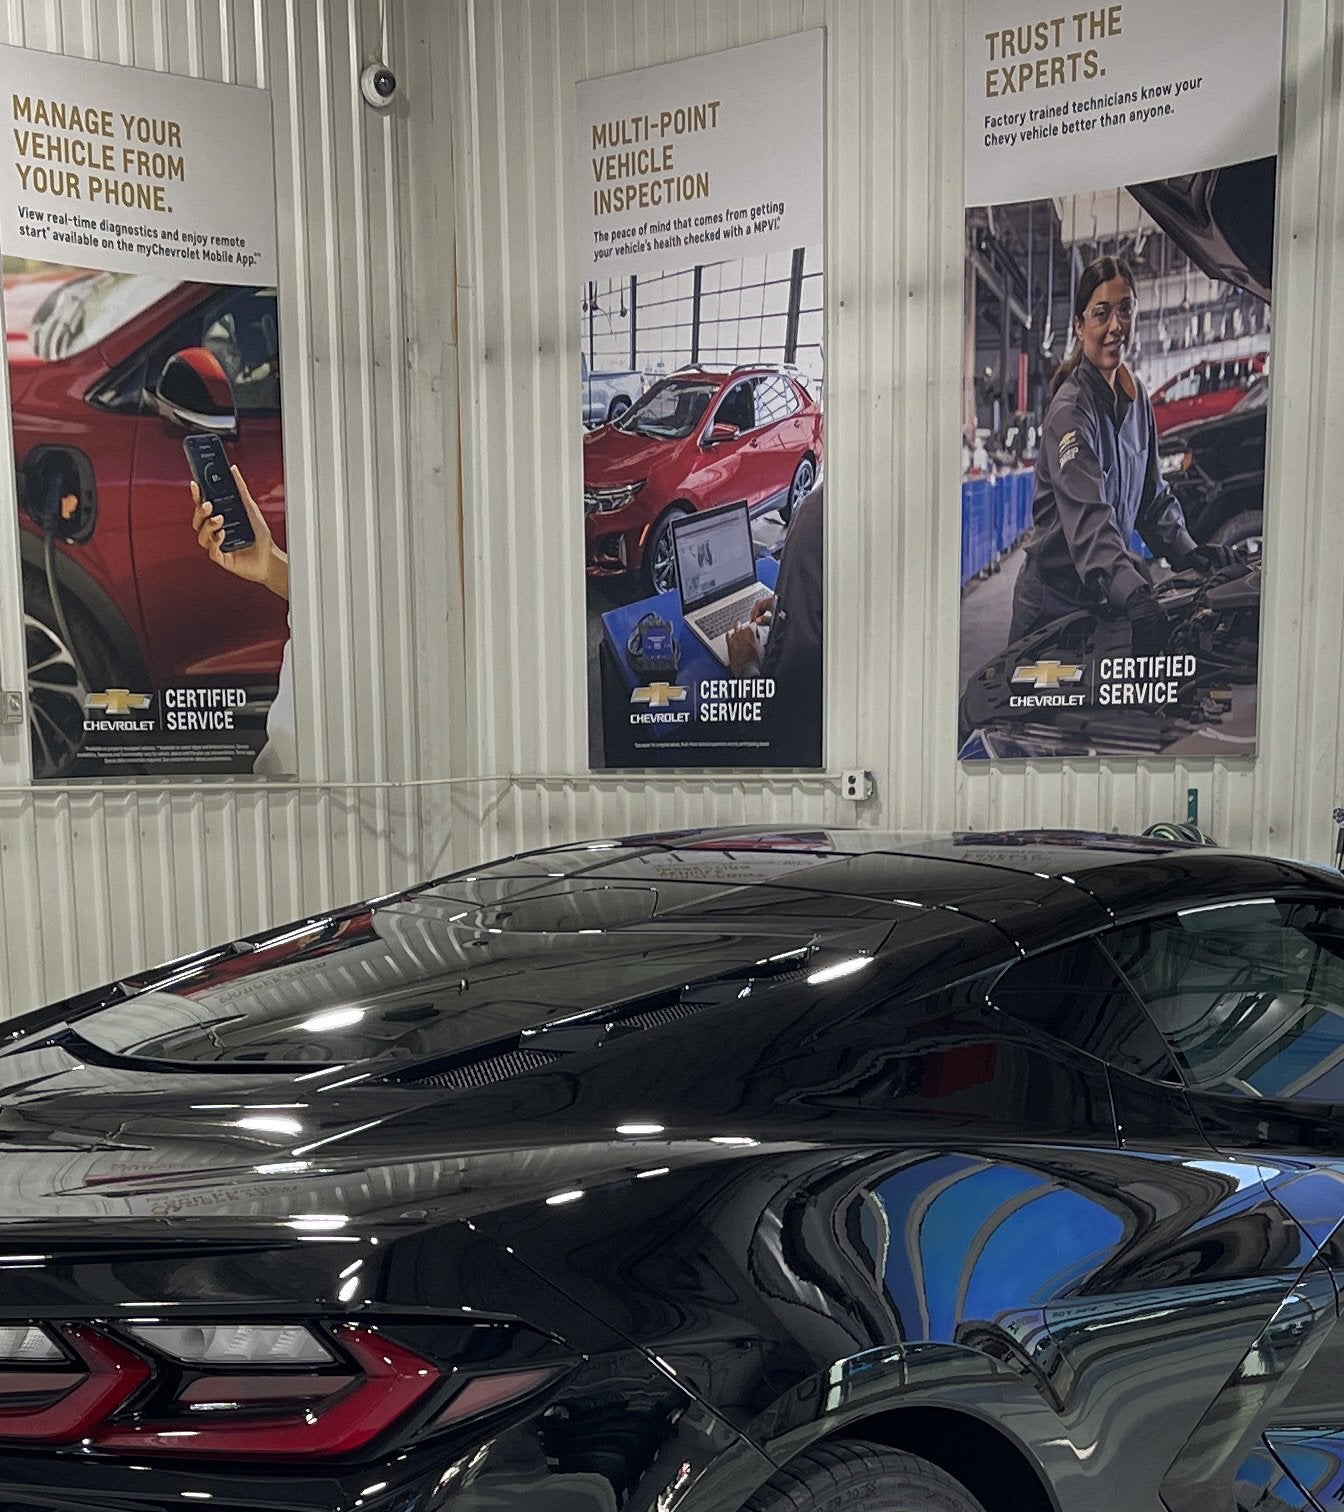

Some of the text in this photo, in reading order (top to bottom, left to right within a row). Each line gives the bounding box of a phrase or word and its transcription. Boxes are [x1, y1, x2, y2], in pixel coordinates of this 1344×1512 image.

[984, 5, 1123, 61] TRUST THE
[985, 49, 1106, 98] EXPERTS.
[12, 94, 182, 149] MANAGE YOUR
[984, 77, 1203, 129] Factory trained technicians know your
[592, 101, 721, 150] MULTI-POINT
[984, 103, 1175, 147] Chevy vehicle better than anyone.
[13, 128, 186, 182] VEHICLE FROM
[592, 144, 674, 182] VEHICLE
[15, 162, 173, 213] YOUR PHONE.
[593, 172, 709, 216] INSPECTION
[17, 205, 246, 249] View real-time diagnostics and enjoy remote
[593, 202, 785, 244] The peace of mind that comes from getting
[52, 229, 99, 248] available
[102, 239, 115, 249] on
[117, 239, 134, 252] the
[137, 242, 200, 260] myChevrolet
[202, 250, 234, 264] Mobile
[593, 247, 613, 262] your
[615, 239, 652, 257] vehicle's
[653, 235, 682, 250] health
[683, 230, 721, 245] checked
[722, 226, 744, 239] with
[746, 226, 752, 235] a
[1100, 655, 1197, 680] CERTIFIED
[165, 688, 247, 709] CERTIFIED
[699, 679, 776, 700] CERTIFIED
[1009, 695, 1086, 707] CHEVROLET
[1099, 682, 1179, 706] SERVICE
[83, 720, 155, 732] CHEVROLET
[166, 711, 235, 731] SERVICE
[630, 712, 690, 725] CHEVROLET
[700, 702, 762, 723] SERVICE
